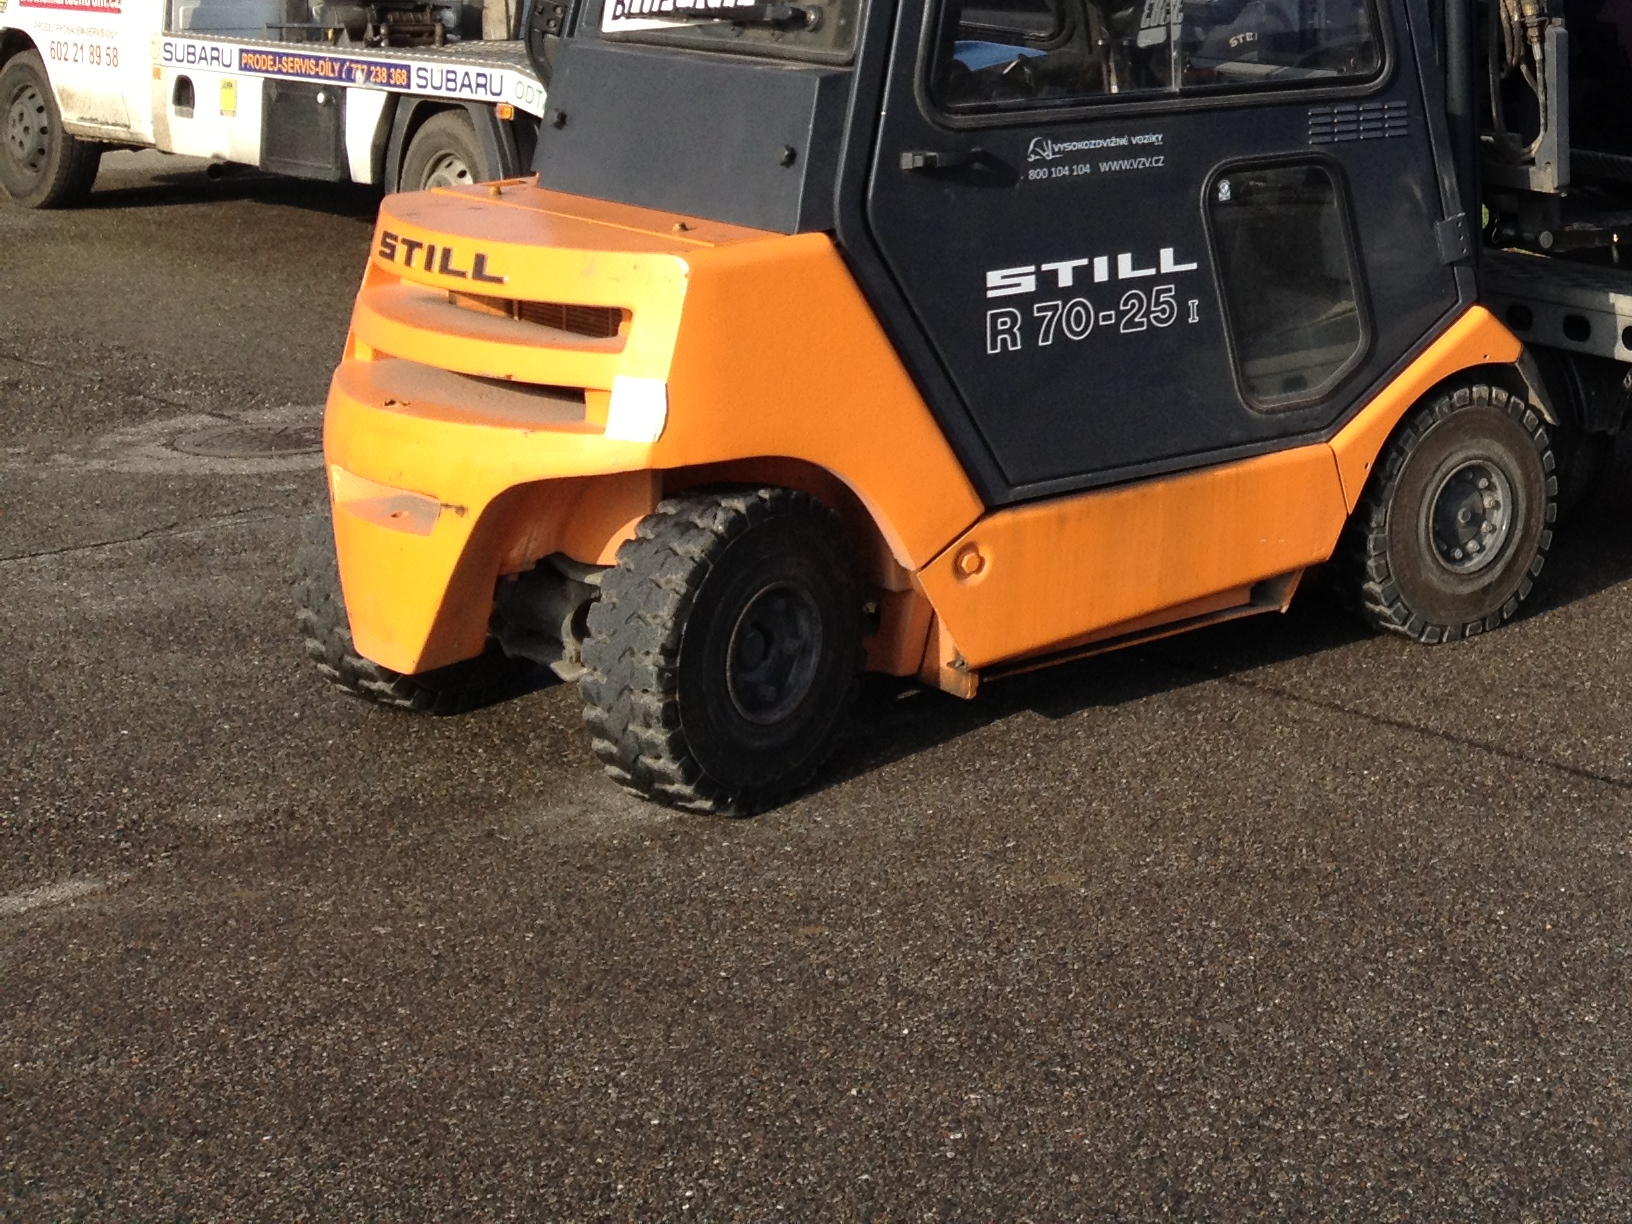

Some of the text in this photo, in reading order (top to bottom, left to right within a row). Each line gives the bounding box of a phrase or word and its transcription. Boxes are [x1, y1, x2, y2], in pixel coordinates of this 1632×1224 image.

[50, 40, 119, 68] 602 21 89 58
[162, 42, 233, 68] SUBARU
[241, 52, 340, 78] PRODEJ-SERVIS-DÍLY
[369, 65, 387, 83] 238
[389, 67, 407, 86] 368
[416, 66, 504, 97] SUBARU
[515, 80, 546, 111] ODT
[1028, 156, 1165, 180] 800 104 104 WWW.VZV.CZ
[1052, 133, 1163, 153] VYSOKOZDVIŽNÉ VOZÍKY
[379, 230, 506, 284] STILL
[986, 247, 1198, 298] STILL
[987, 307, 1021, 354] R
[1033, 284, 1177, 346] 70-25
